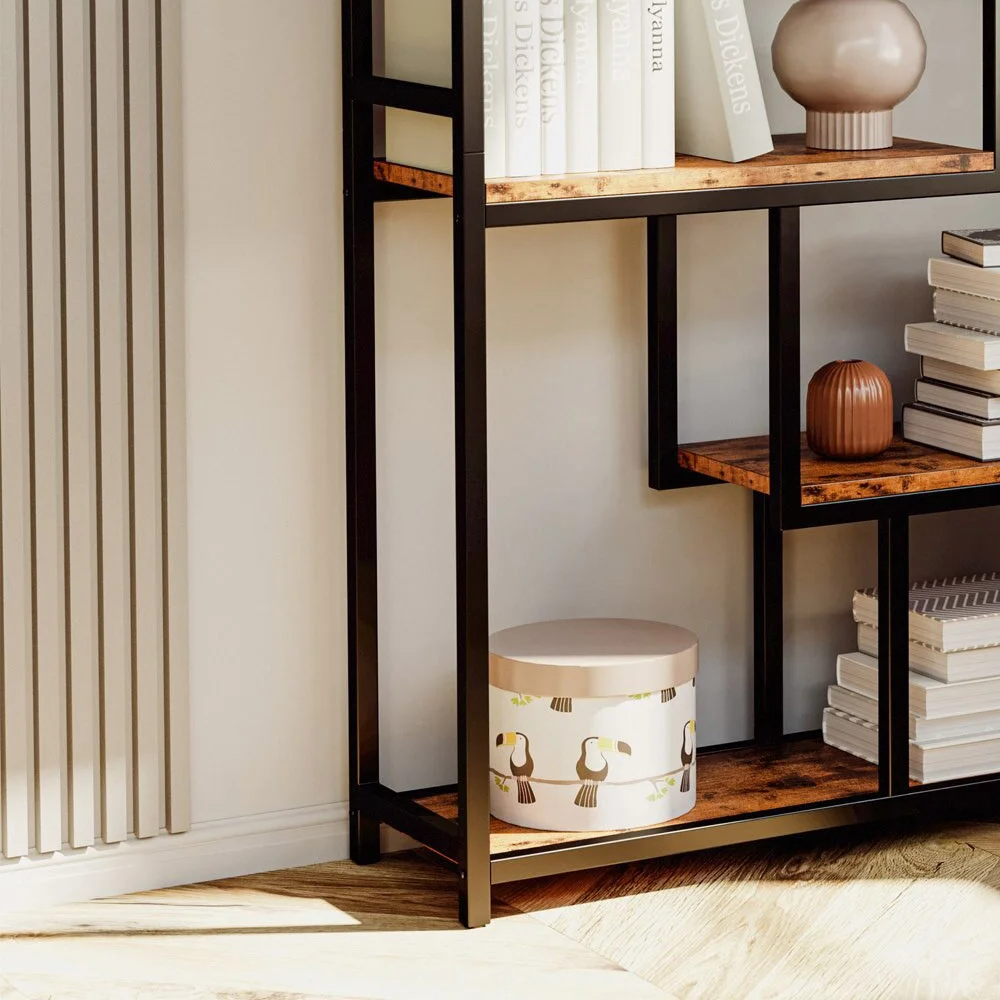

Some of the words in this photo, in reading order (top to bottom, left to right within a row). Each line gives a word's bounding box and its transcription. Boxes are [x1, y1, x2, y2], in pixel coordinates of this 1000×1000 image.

[514, 21, 535, 128] Dickens
[540, 17, 565, 124] Dickens
[714, 14, 751, 115] Dickens
